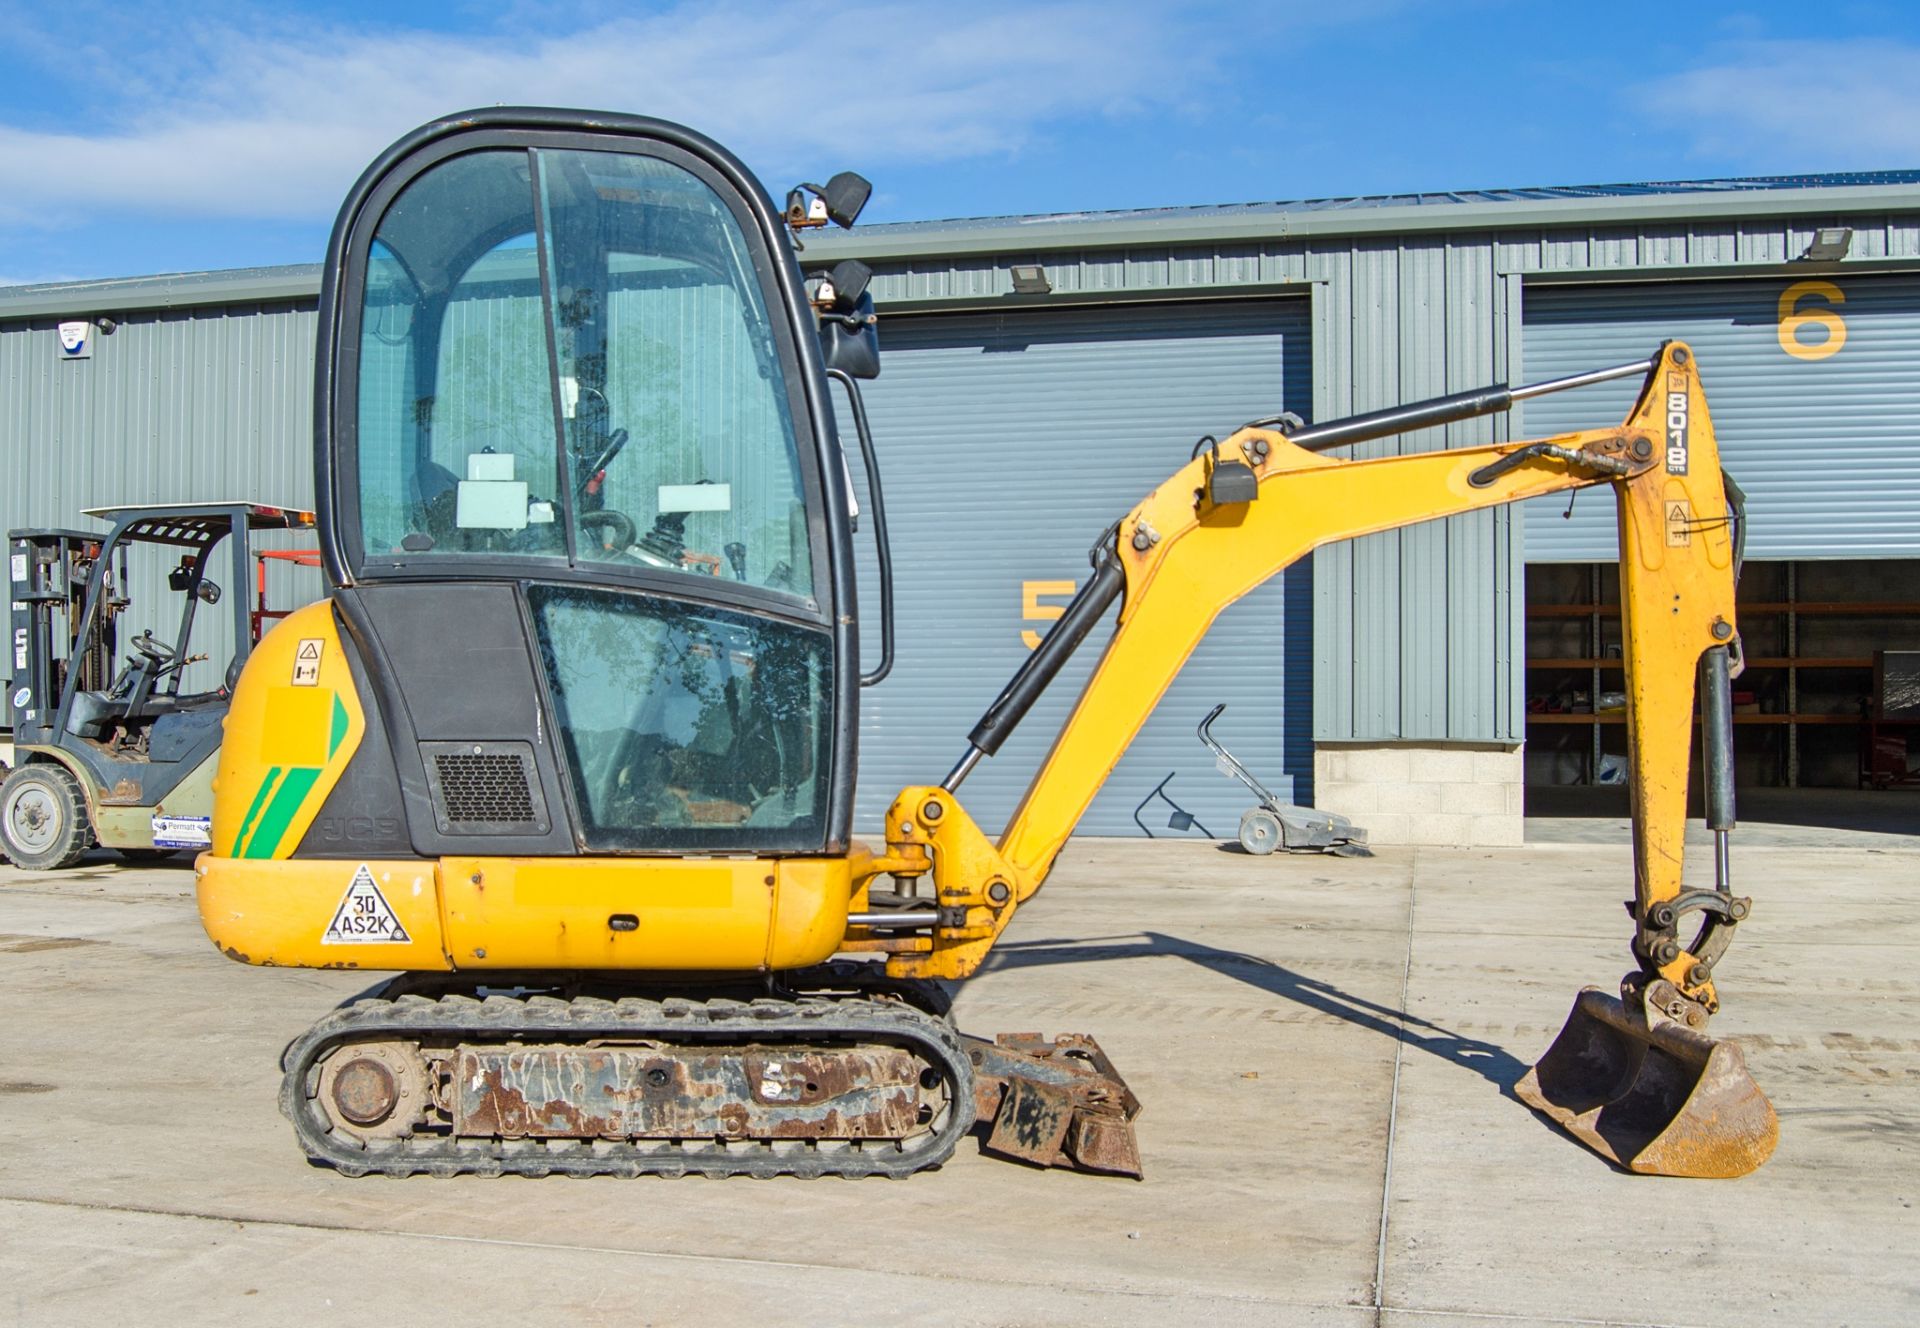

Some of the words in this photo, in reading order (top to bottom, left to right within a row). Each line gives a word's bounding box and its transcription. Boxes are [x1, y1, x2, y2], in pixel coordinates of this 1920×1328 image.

[1778, 281, 1847, 360] 6
[1667, 393, 1687, 466] 8018
[1021, 580, 1076, 651] 5
[168, 821, 195, 831] Permatt
[321, 817, 401, 841] JCB
[342, 916, 390, 934] AS2K
